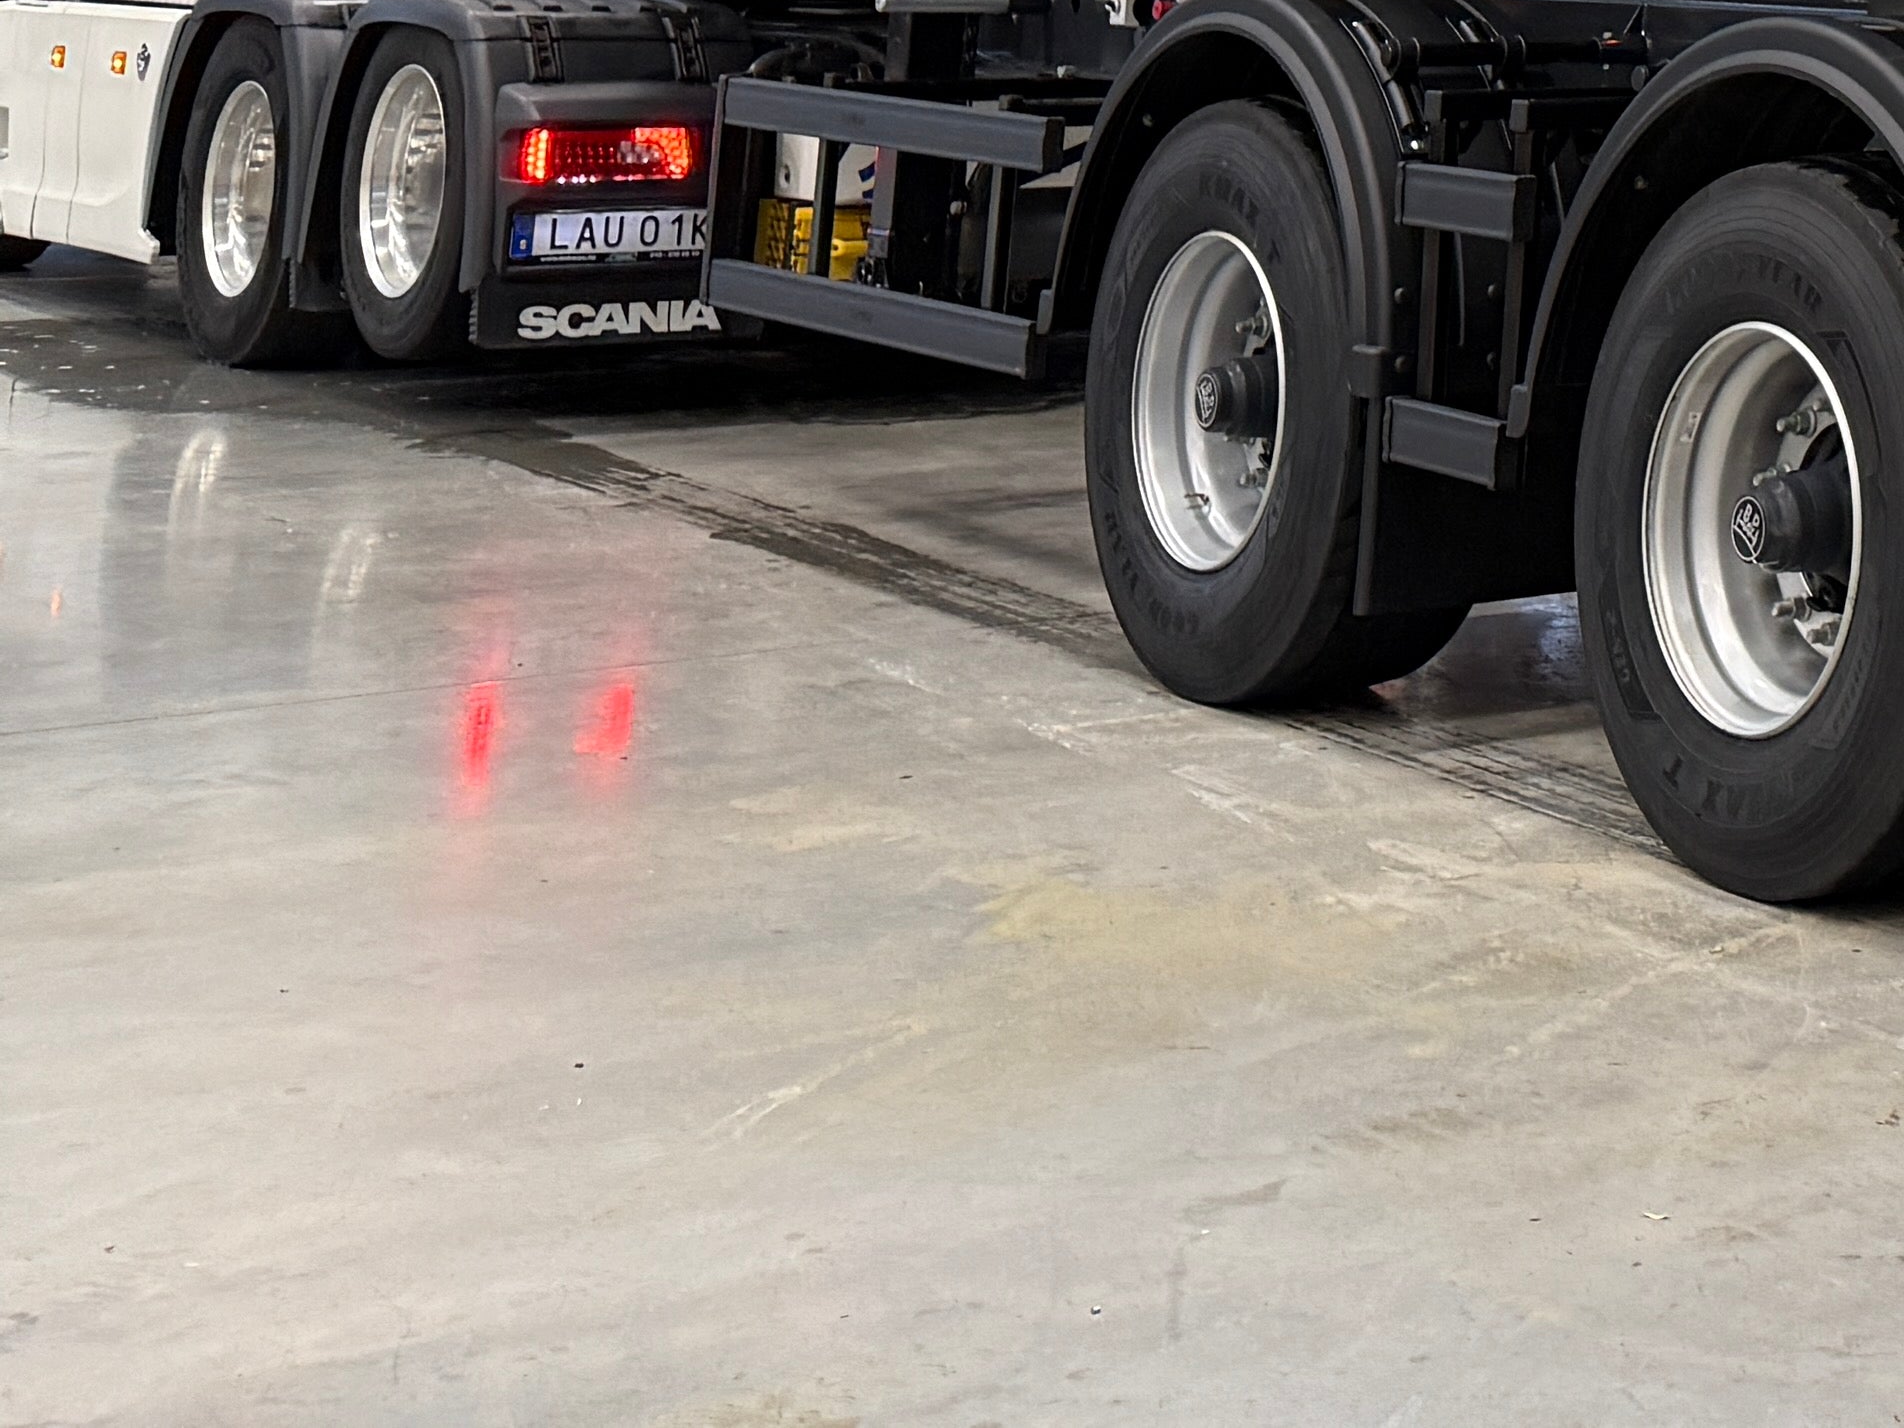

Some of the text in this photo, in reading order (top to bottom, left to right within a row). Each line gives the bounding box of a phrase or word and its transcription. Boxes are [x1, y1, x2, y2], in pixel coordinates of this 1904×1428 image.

[550, 213, 708, 250] LAU 01K
[517, 299, 722, 340] SCANIA
